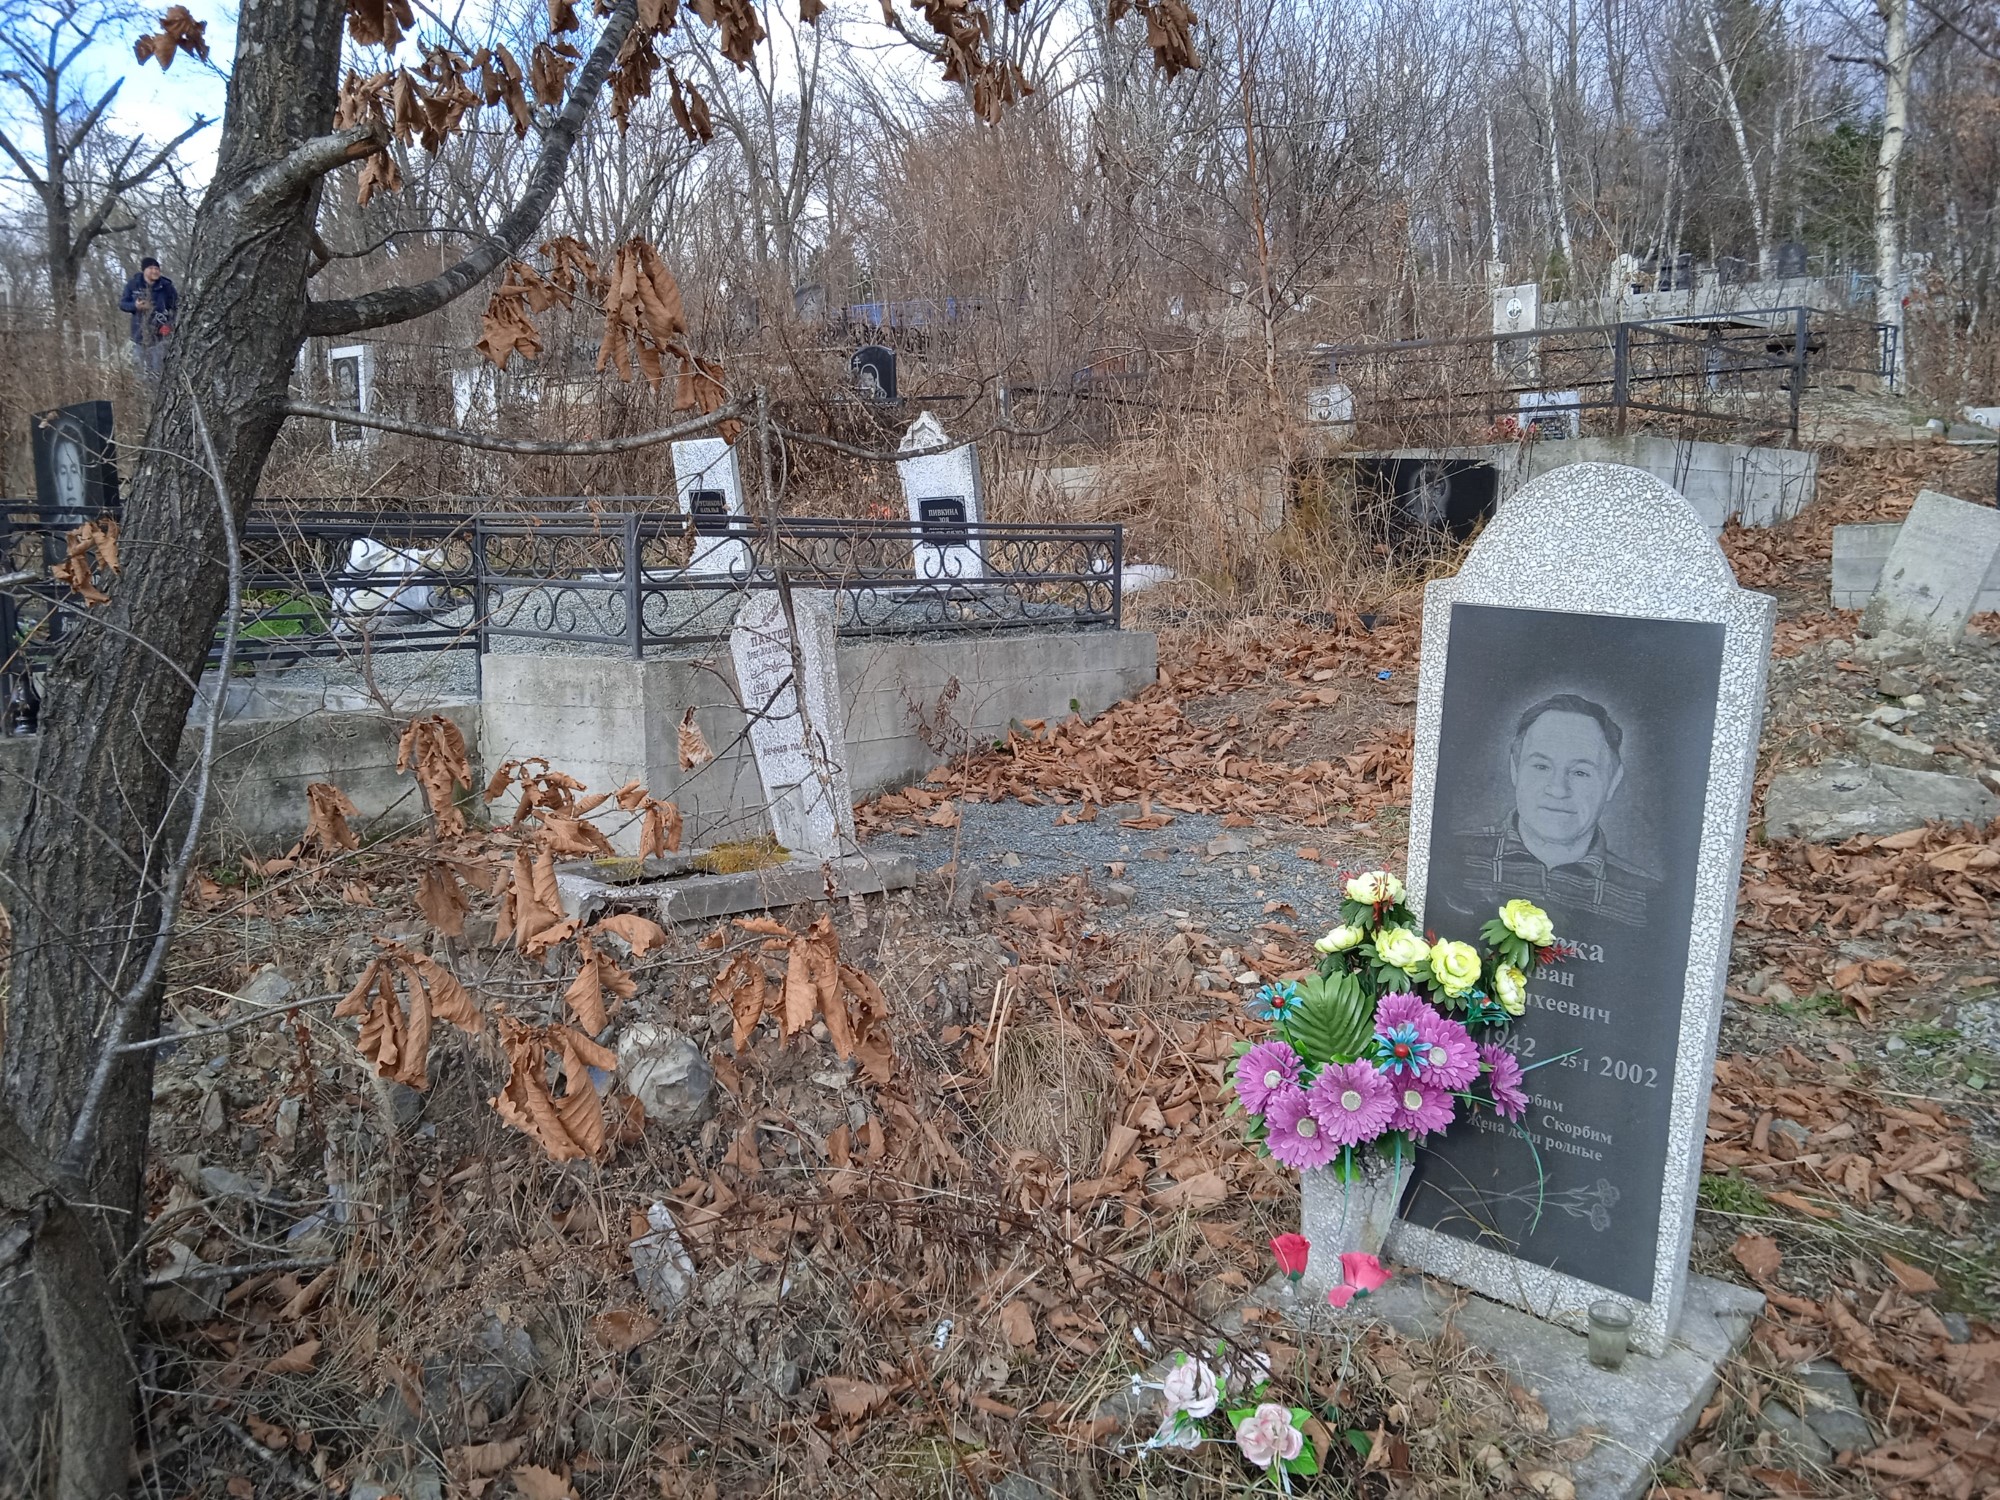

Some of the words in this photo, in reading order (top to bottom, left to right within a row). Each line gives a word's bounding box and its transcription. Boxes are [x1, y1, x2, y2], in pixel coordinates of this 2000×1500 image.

[1484, 1027, 1537, 1059] 1942
[1599, 1055, 1659, 1089] 2002
[1466, 1111, 1506, 1134] Жена
[1545, 1136, 1603, 1162] родные
[1541, 1114, 1613, 1146] Скорбим
